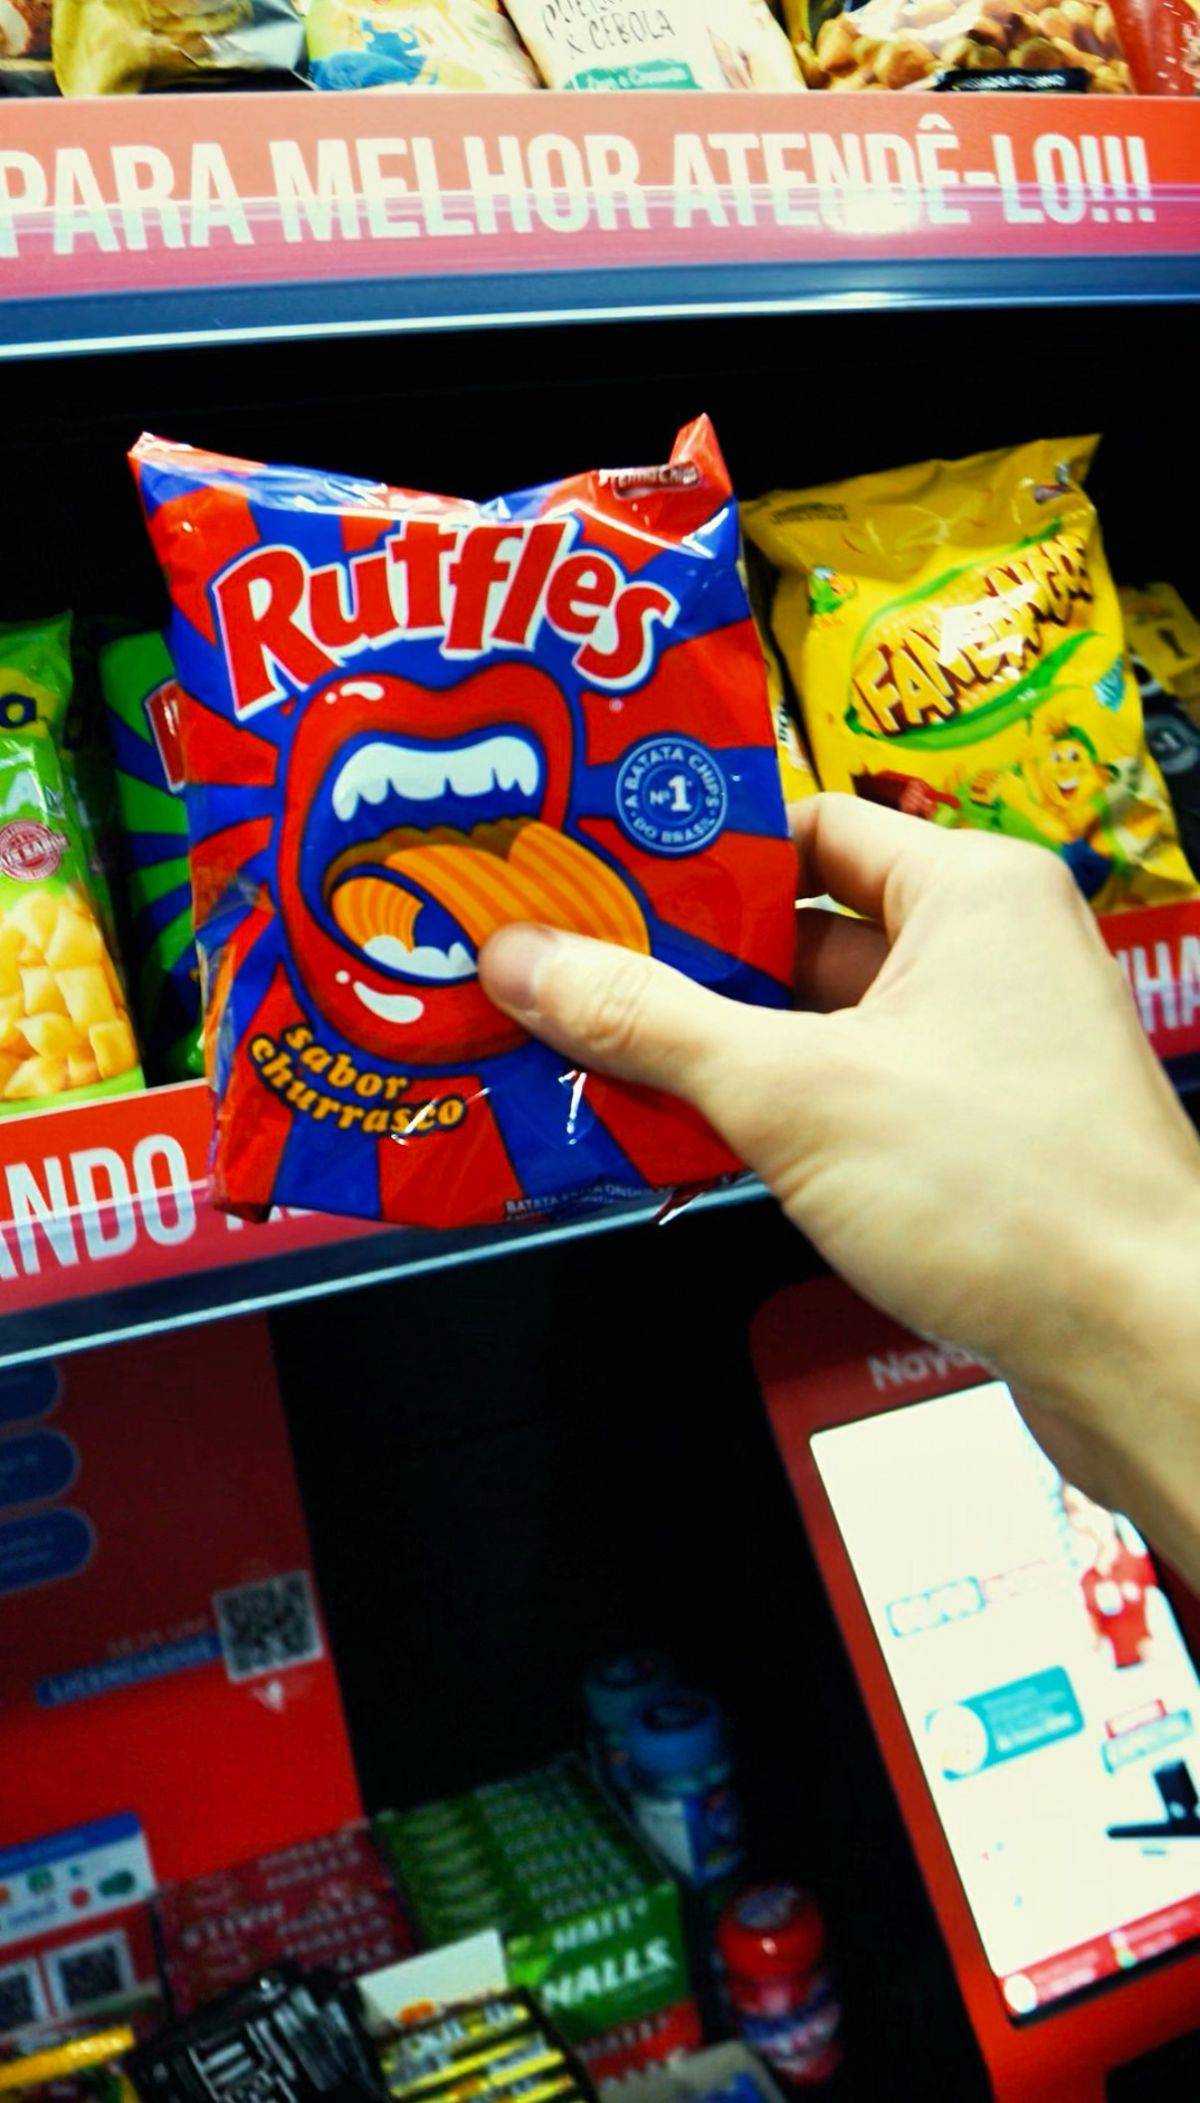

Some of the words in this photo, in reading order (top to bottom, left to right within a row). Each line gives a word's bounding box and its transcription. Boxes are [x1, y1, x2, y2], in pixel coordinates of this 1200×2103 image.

[0, 143, 255, 259] PARA
[269, 132, 652, 243] MELHOR
[673, 113, 1157, 232] ATENDÊ-LO!!!
[212, 515, 681, 721] Ruffles
[625, 746, 685, 790] BATATA
[625, 795, 639, 808] A
[688, 754, 720, 807] CHIPS
[633, 818, 657, 838] DO
[251, 1038, 465, 1133] churrasco
[285, 1027, 409, 1100] sabor
[0, 1133, 197, 1281] NDO
[506, 1194, 558, 1214] BATATA
[541, 1936, 678, 2008] HALLS
